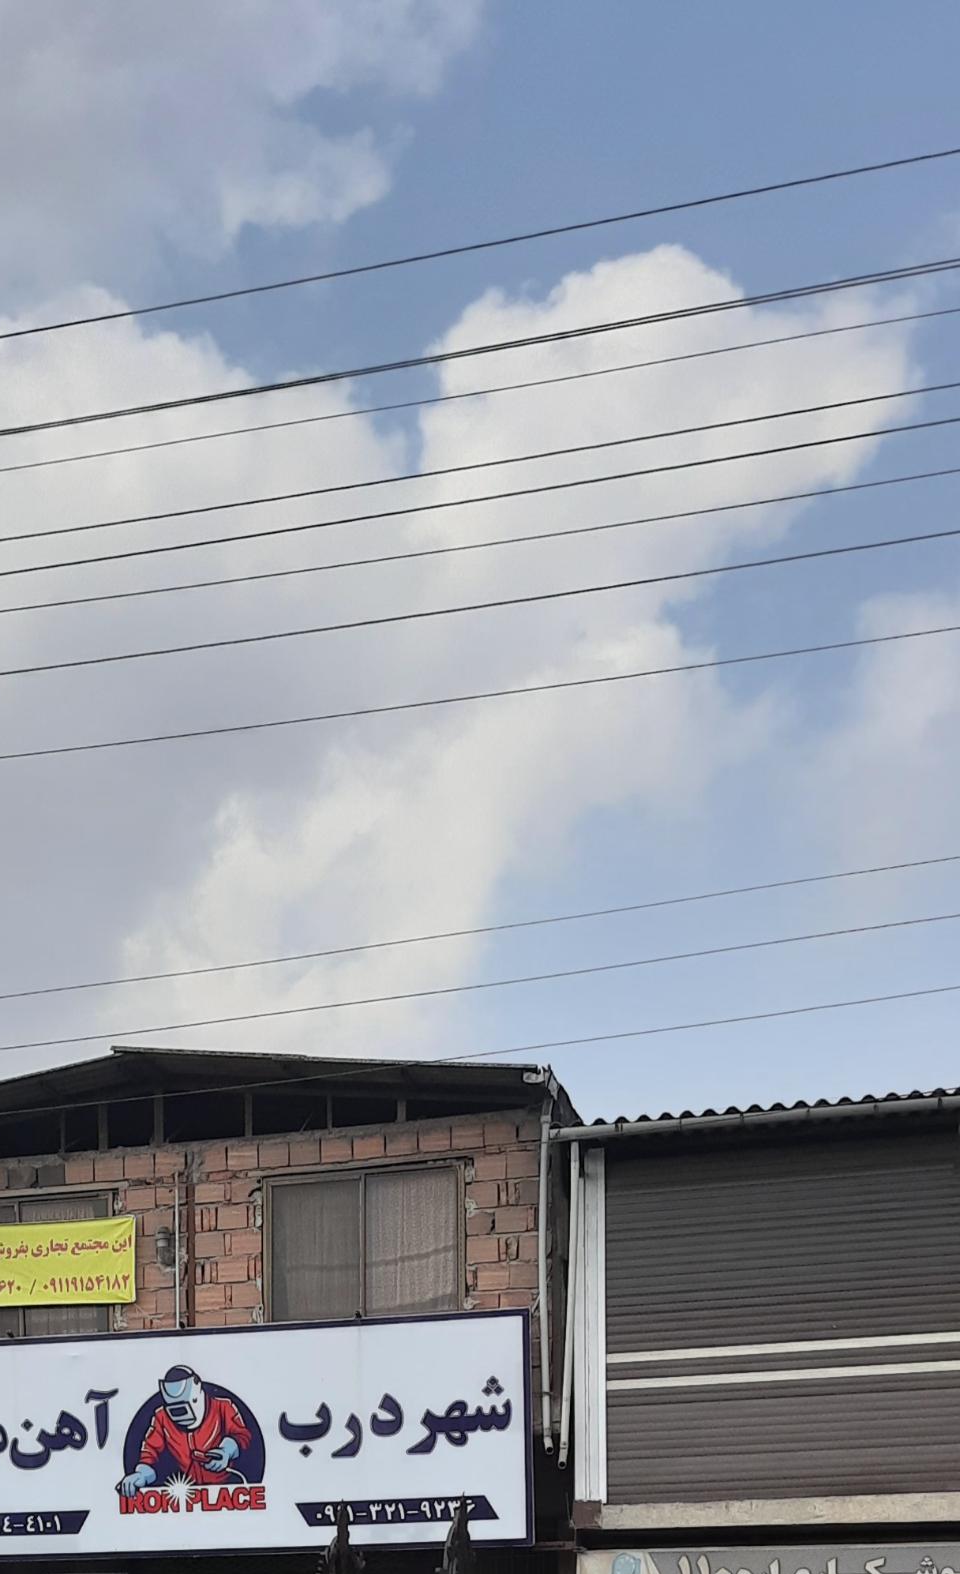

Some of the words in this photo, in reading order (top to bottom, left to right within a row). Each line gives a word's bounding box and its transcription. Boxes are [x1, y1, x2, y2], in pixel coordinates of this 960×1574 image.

[30, 1238, 69, 1258] تجاری
[70, 1238, 109, 1256] مجتمع
[111, 1234, 132, 1253] این
[9, 1387, 120, 1471] آهن
[278, 1392, 405, 1459] درب
[406, 1375, 513, 1456] شهر
[186, 1486, 267, 1513] PLACE
